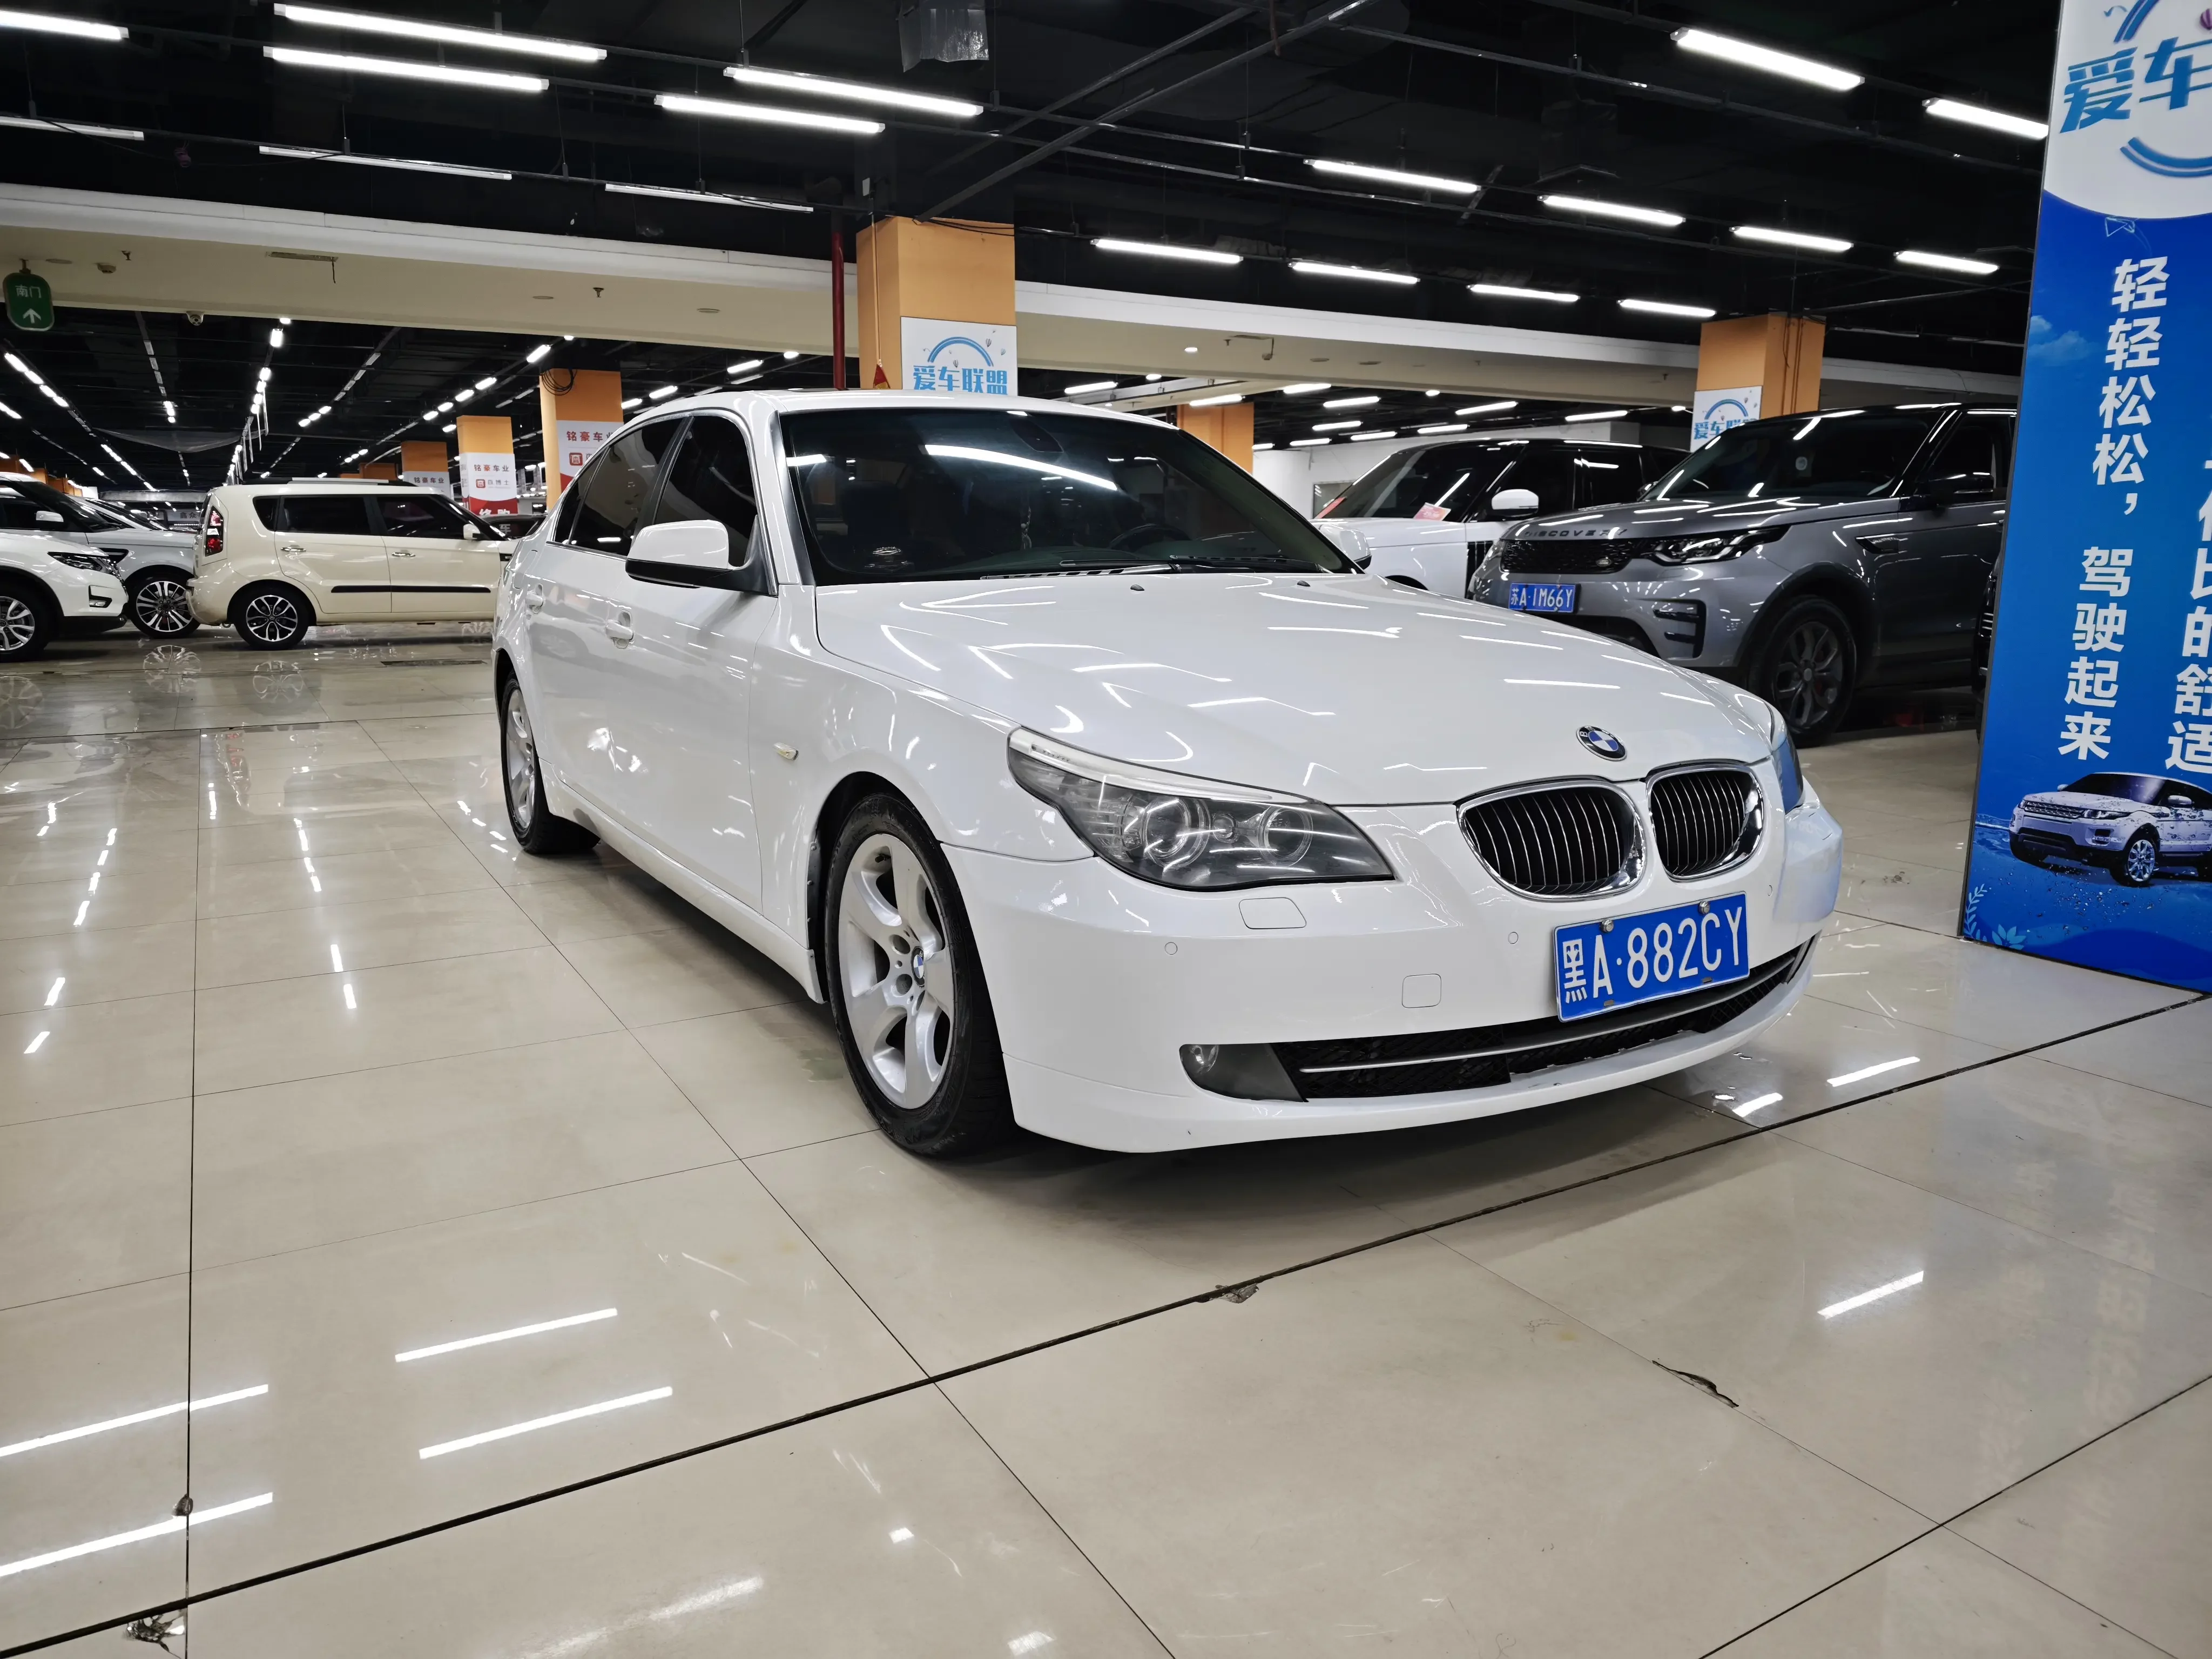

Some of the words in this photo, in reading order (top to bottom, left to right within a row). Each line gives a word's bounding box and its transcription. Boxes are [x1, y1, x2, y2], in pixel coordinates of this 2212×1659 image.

[2060, 37, 2212, 133] 爱车
[15, 285, 42, 298] 南门
[913, 365, 1008, 395] 爱车联盟
[1694, 418, 1757, 440] 爱车
[1525, 529, 1628, 537] DISCOVERY
